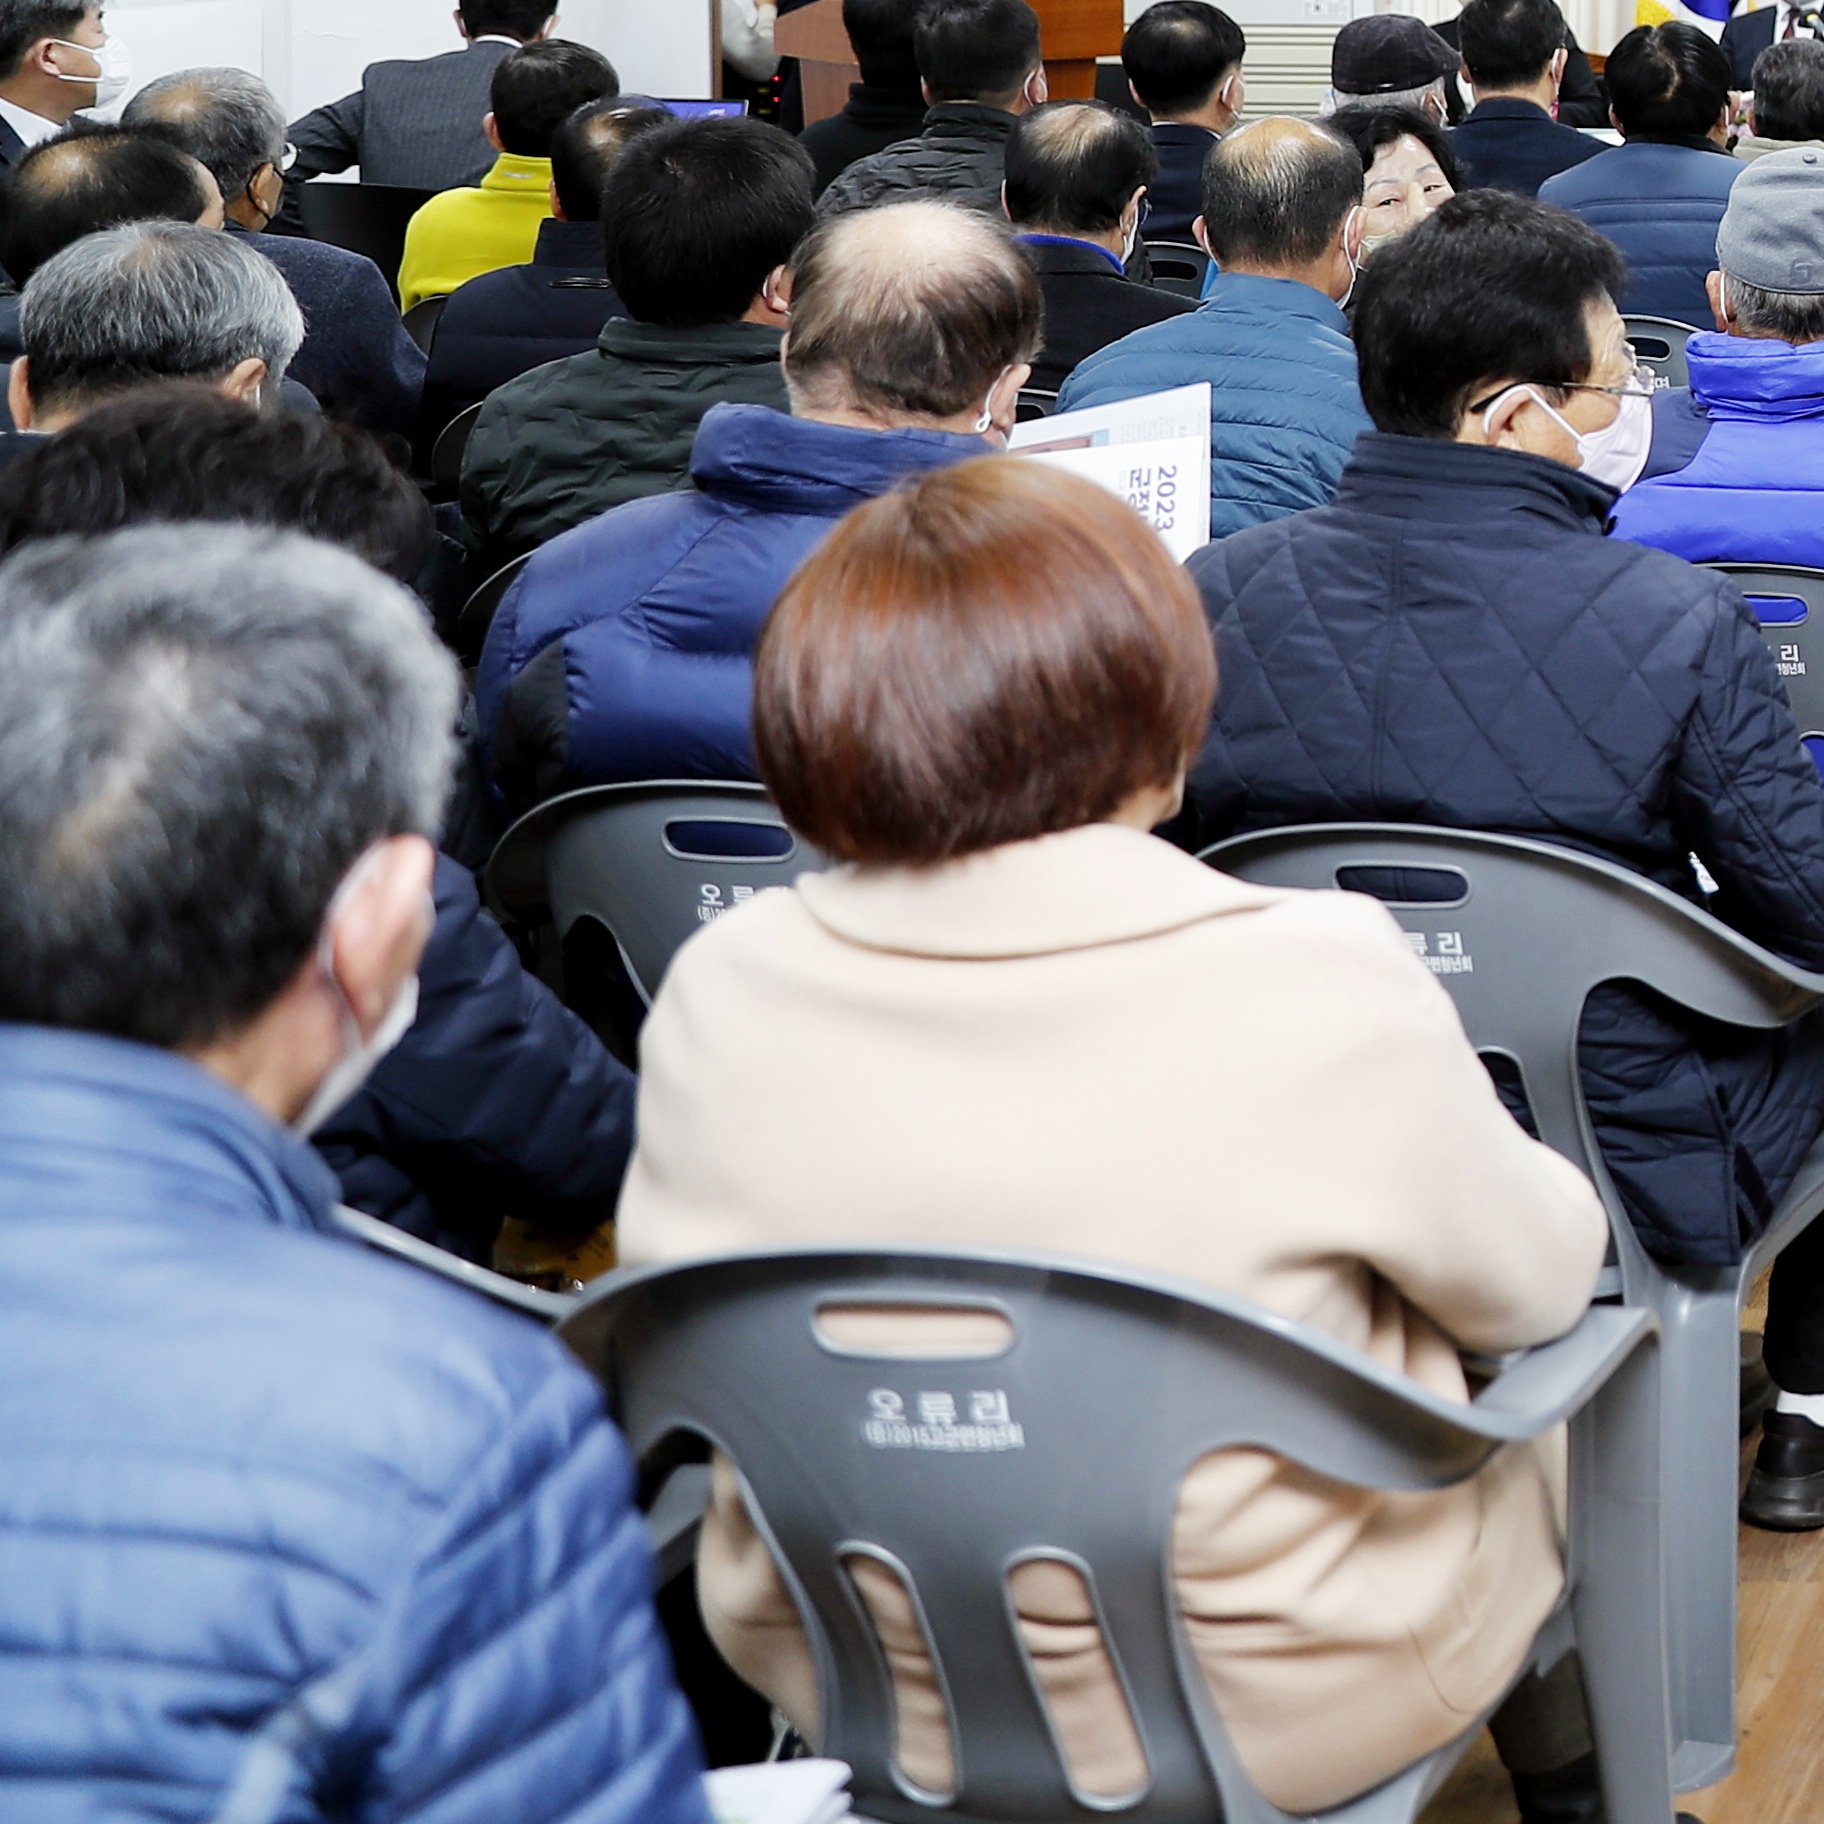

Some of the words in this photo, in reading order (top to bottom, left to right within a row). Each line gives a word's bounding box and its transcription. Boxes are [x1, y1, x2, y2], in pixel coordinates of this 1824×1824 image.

[1128, 467, 1152, 522] 군정
[1154, 464, 1178, 532] 2023
[1404, 931, 1464, 955] 류리
